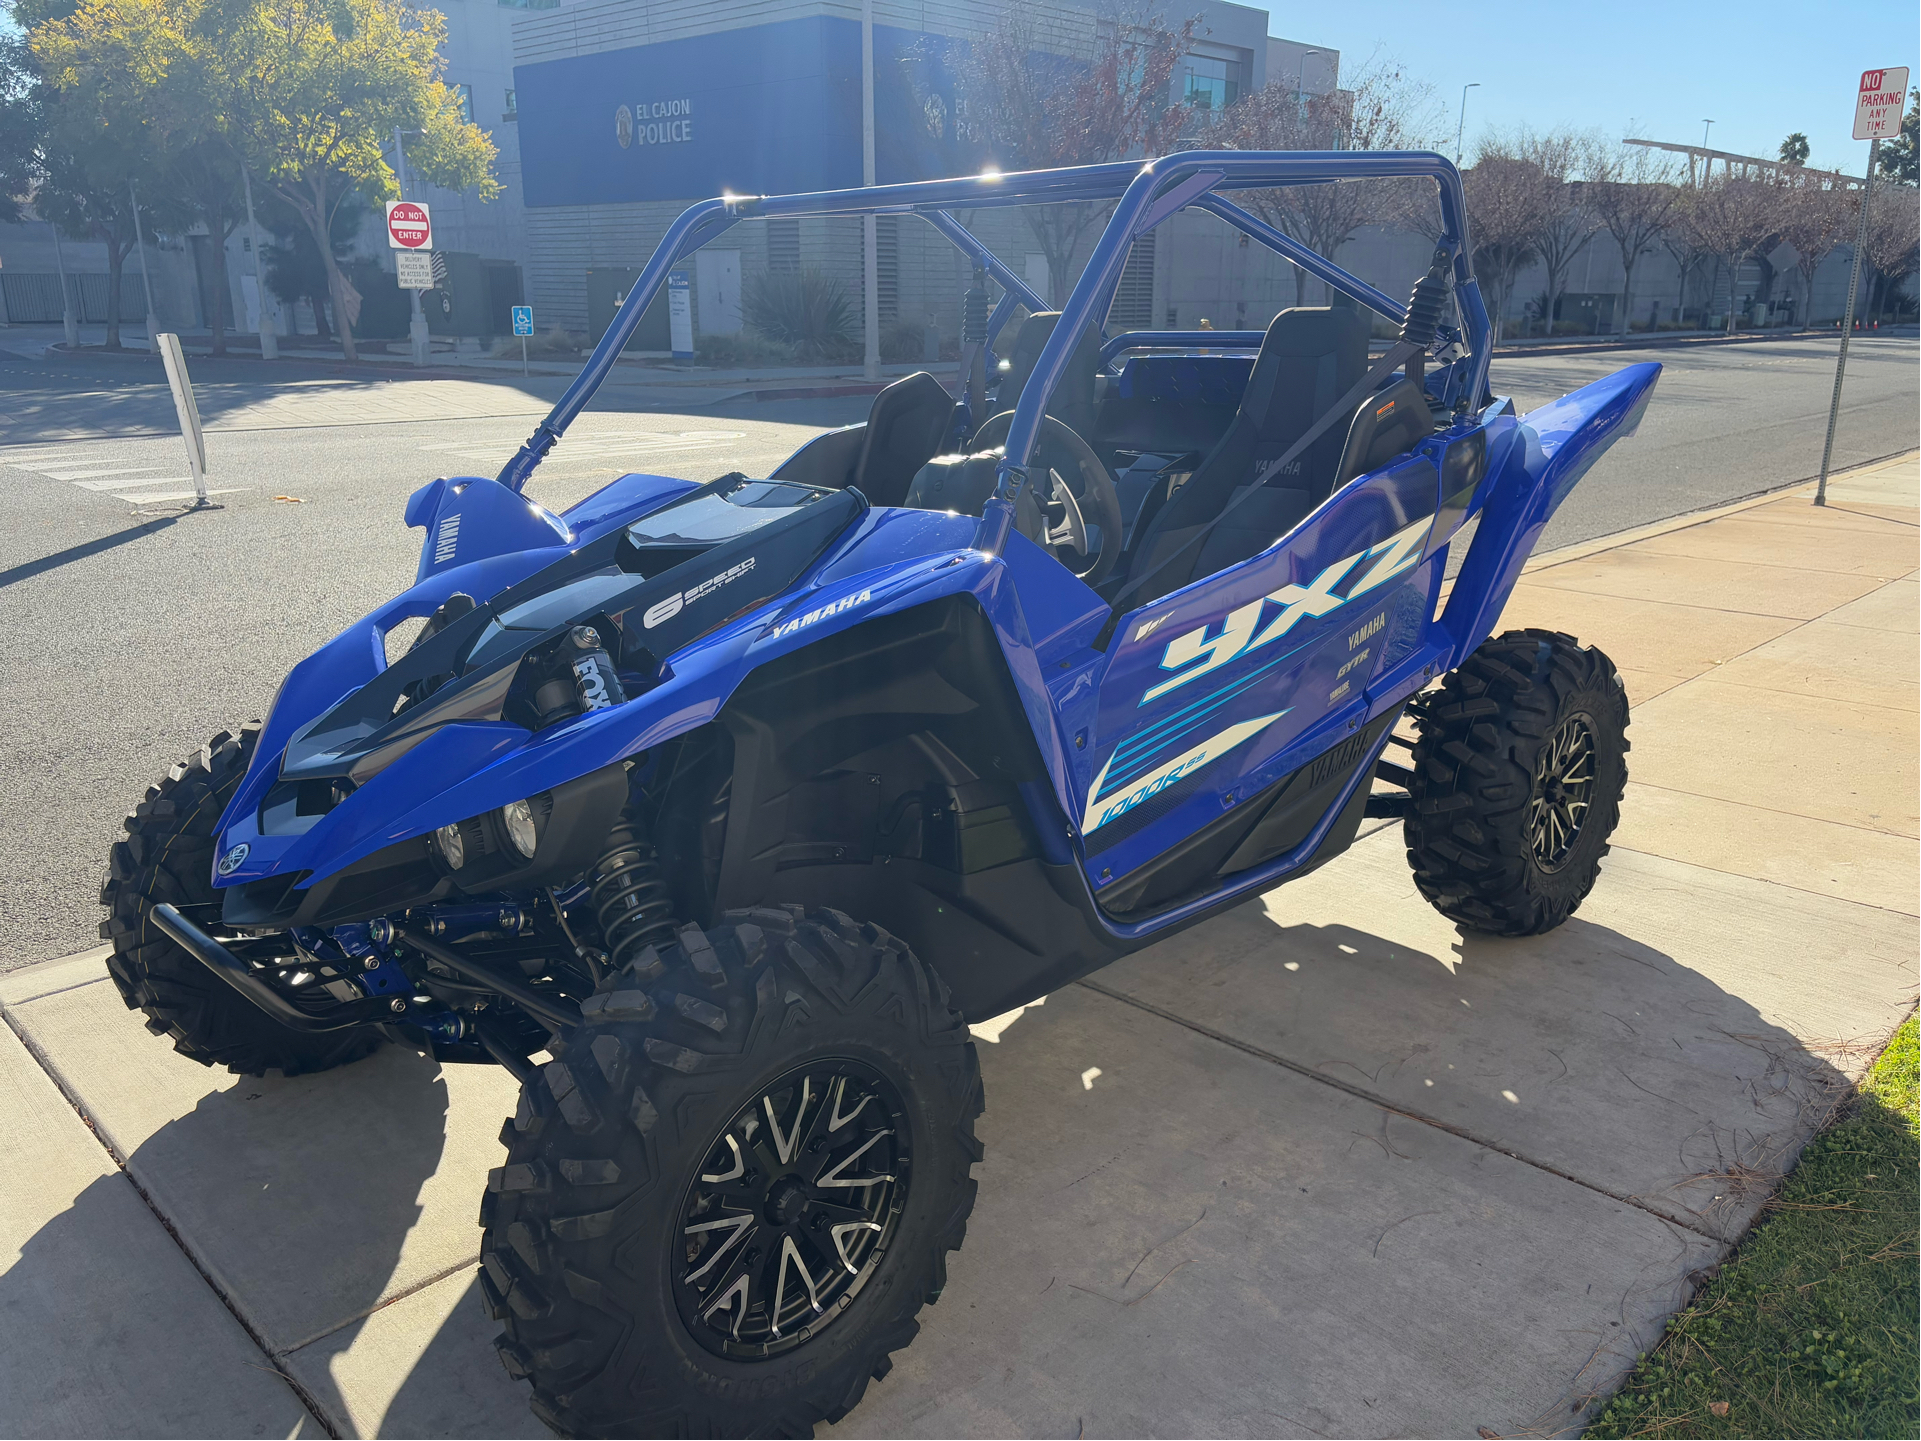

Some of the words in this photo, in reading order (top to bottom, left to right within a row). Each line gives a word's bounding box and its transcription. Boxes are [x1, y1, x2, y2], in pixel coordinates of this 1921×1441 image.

[1863, 72, 1880, 89] NO
[636, 104, 650, 120] EL
[651, 98, 691, 118] CAJON
[1861, 91, 1902, 108] PARKING
[1866, 120, 1887, 131] TIME
[1868, 107, 1888, 119] ANY
[638, 120, 692, 145] POLICE
[393, 211, 405, 219] DO
[408, 211, 423, 220] NOT
[398, 231, 422, 240] ENTER
[1255, 459, 1302, 476] YAHA
[434, 512, 462, 564] YAMAHA
[643, 591, 684, 629] 6
[684, 556, 756, 600] SPEED
[772, 589, 871, 640] YAMAHA
[1137, 513, 1436, 708] YXZ
[1348, 611, 1385, 652] YAMAHA
[1335, 647, 1371, 681] GYTR
[573, 656, 612, 711] FOX
[1310, 728, 1370, 789] YAMAHA
